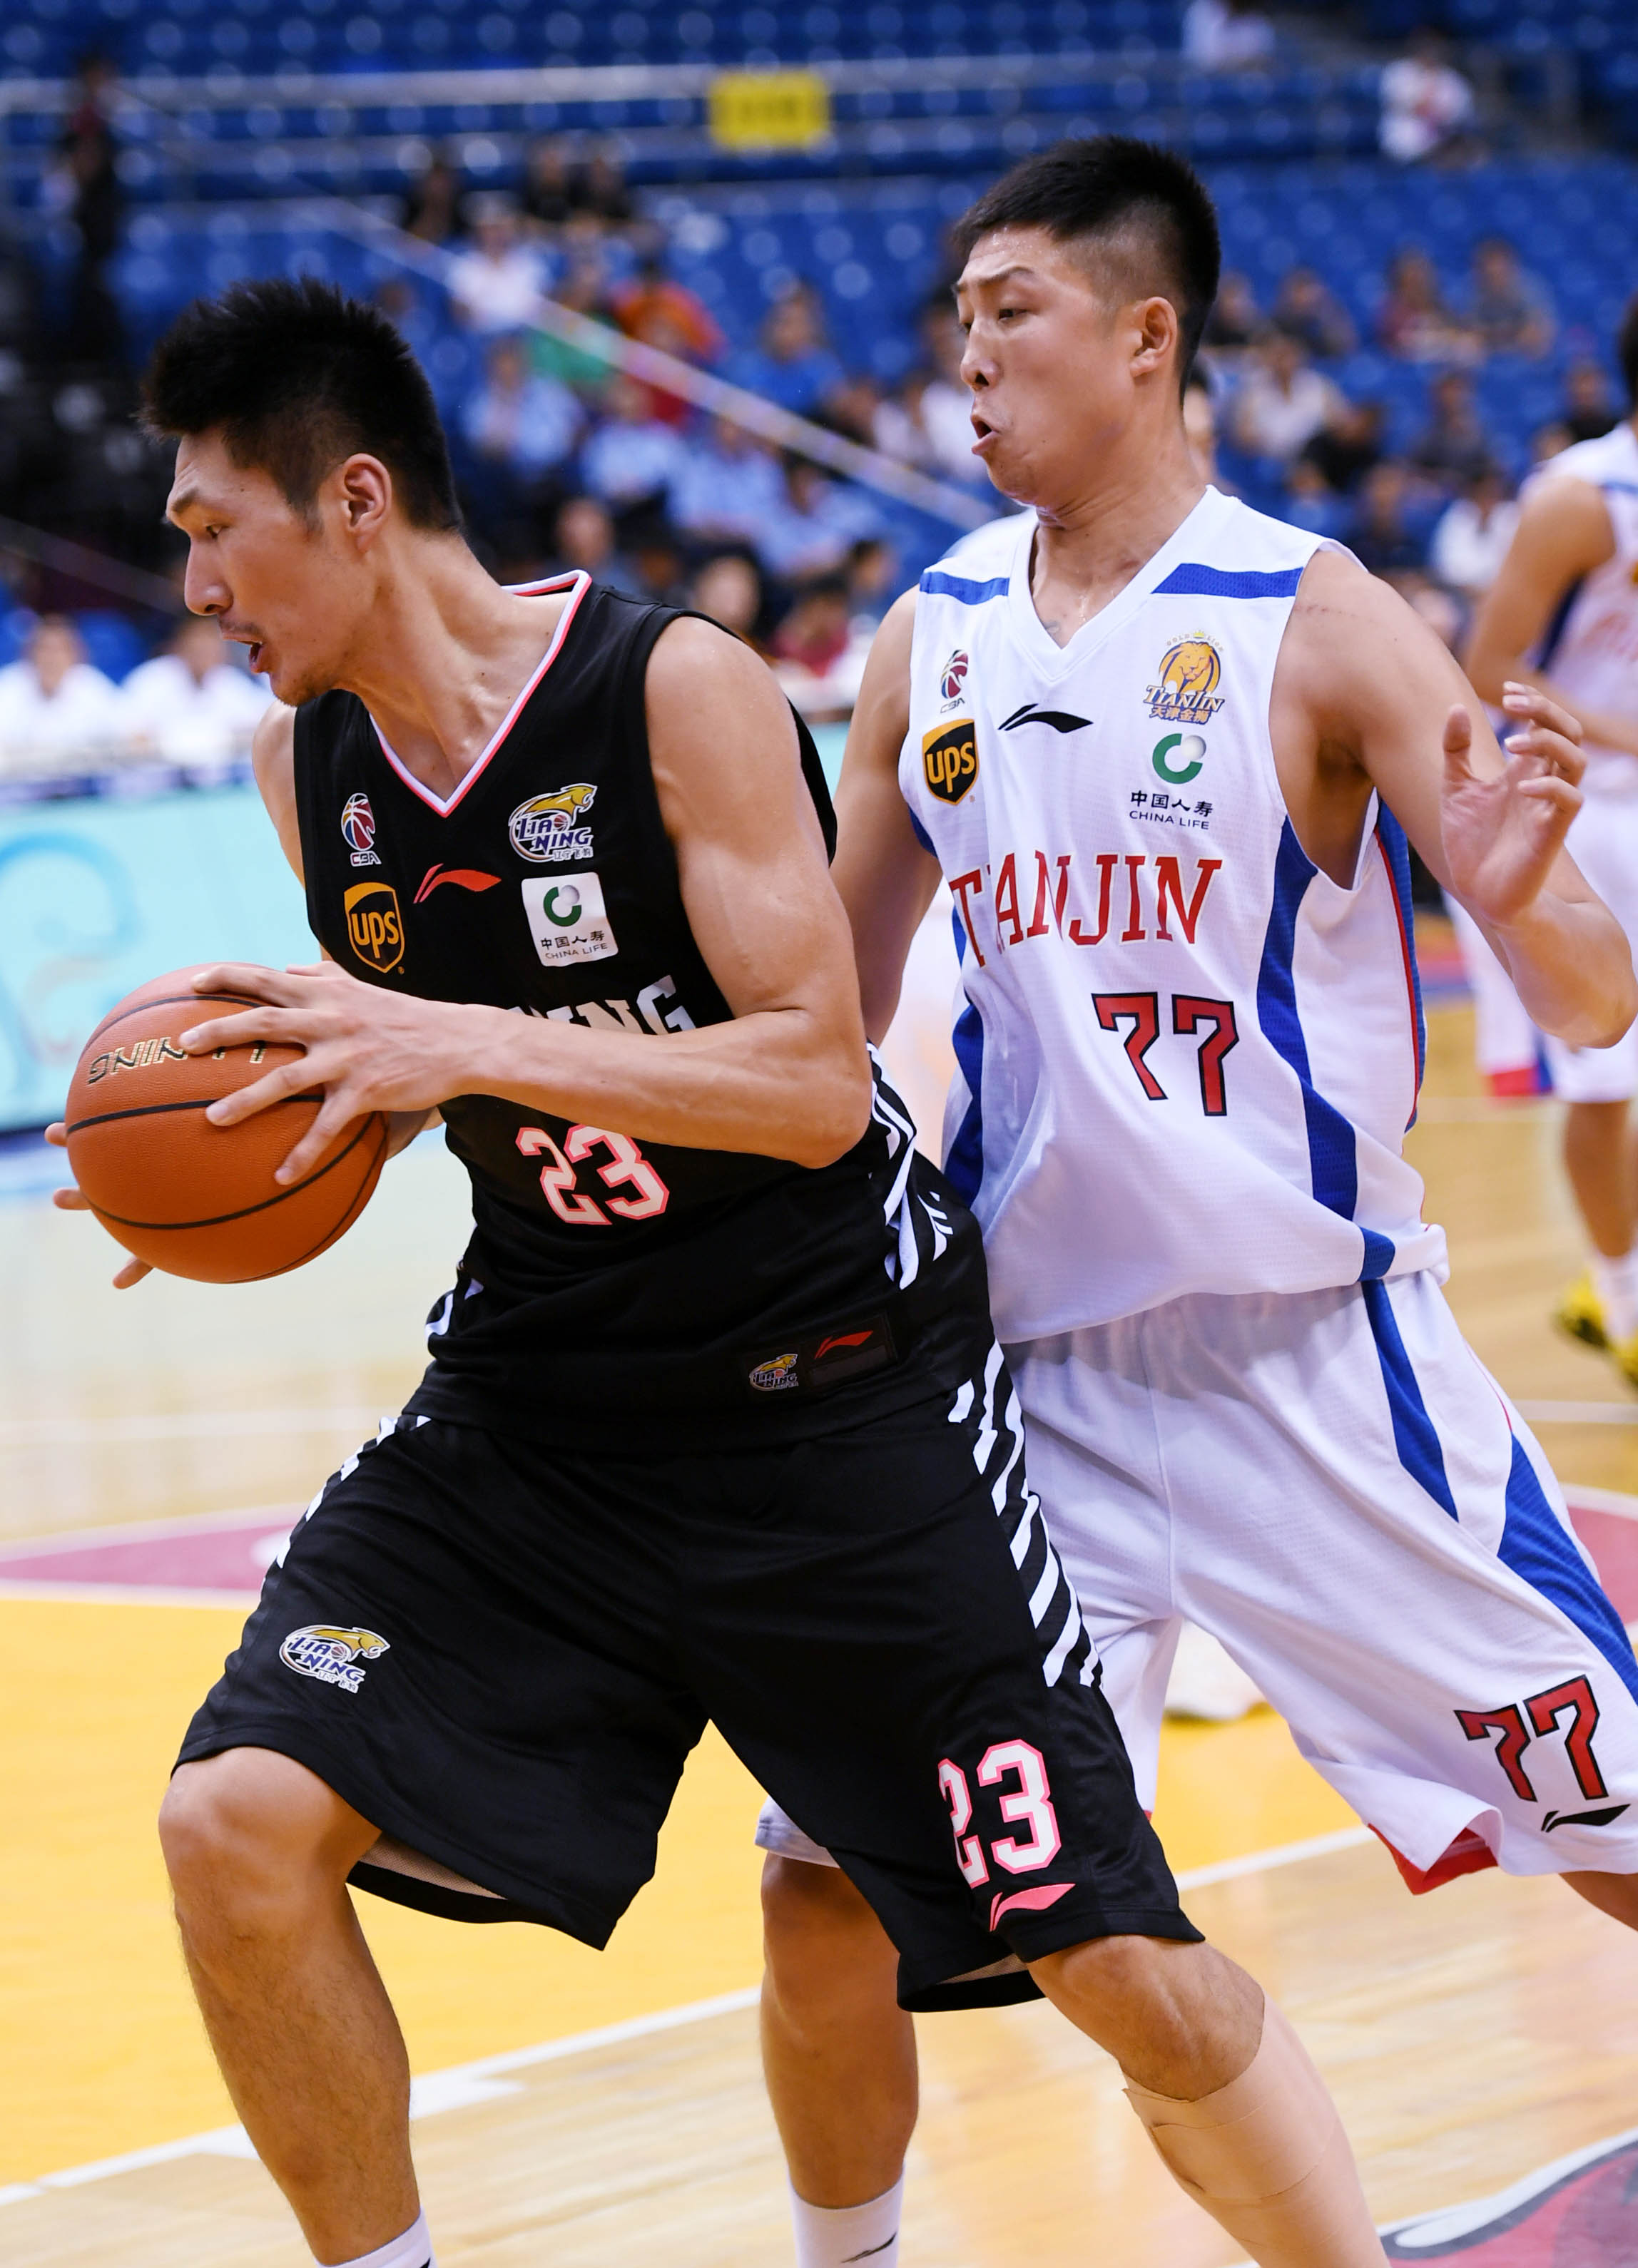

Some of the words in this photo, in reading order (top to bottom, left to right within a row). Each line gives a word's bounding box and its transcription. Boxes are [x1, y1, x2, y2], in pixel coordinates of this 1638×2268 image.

[1130, 790, 1214, 817] 中国人寿
[1129, 810, 1174, 824] CHINA
[1179, 817, 1210, 830] LIFE
[534, 827, 591, 855] NING
[350, 852, 380, 866] CBA
[948, 849, 1224, 968] TANJIN
[540, 930, 605, 951] 中国人寿
[544, 949, 579, 959] CHINA
[582, 942, 608, 954] LIFE
[1091, 991, 1240, 1117] 77
[515, 1123, 671, 1226] 23
[299, 1652, 365, 1683] NING
[1453, 1673, 1609, 1803] 77
[937, 1738, 1062, 1890] 23
